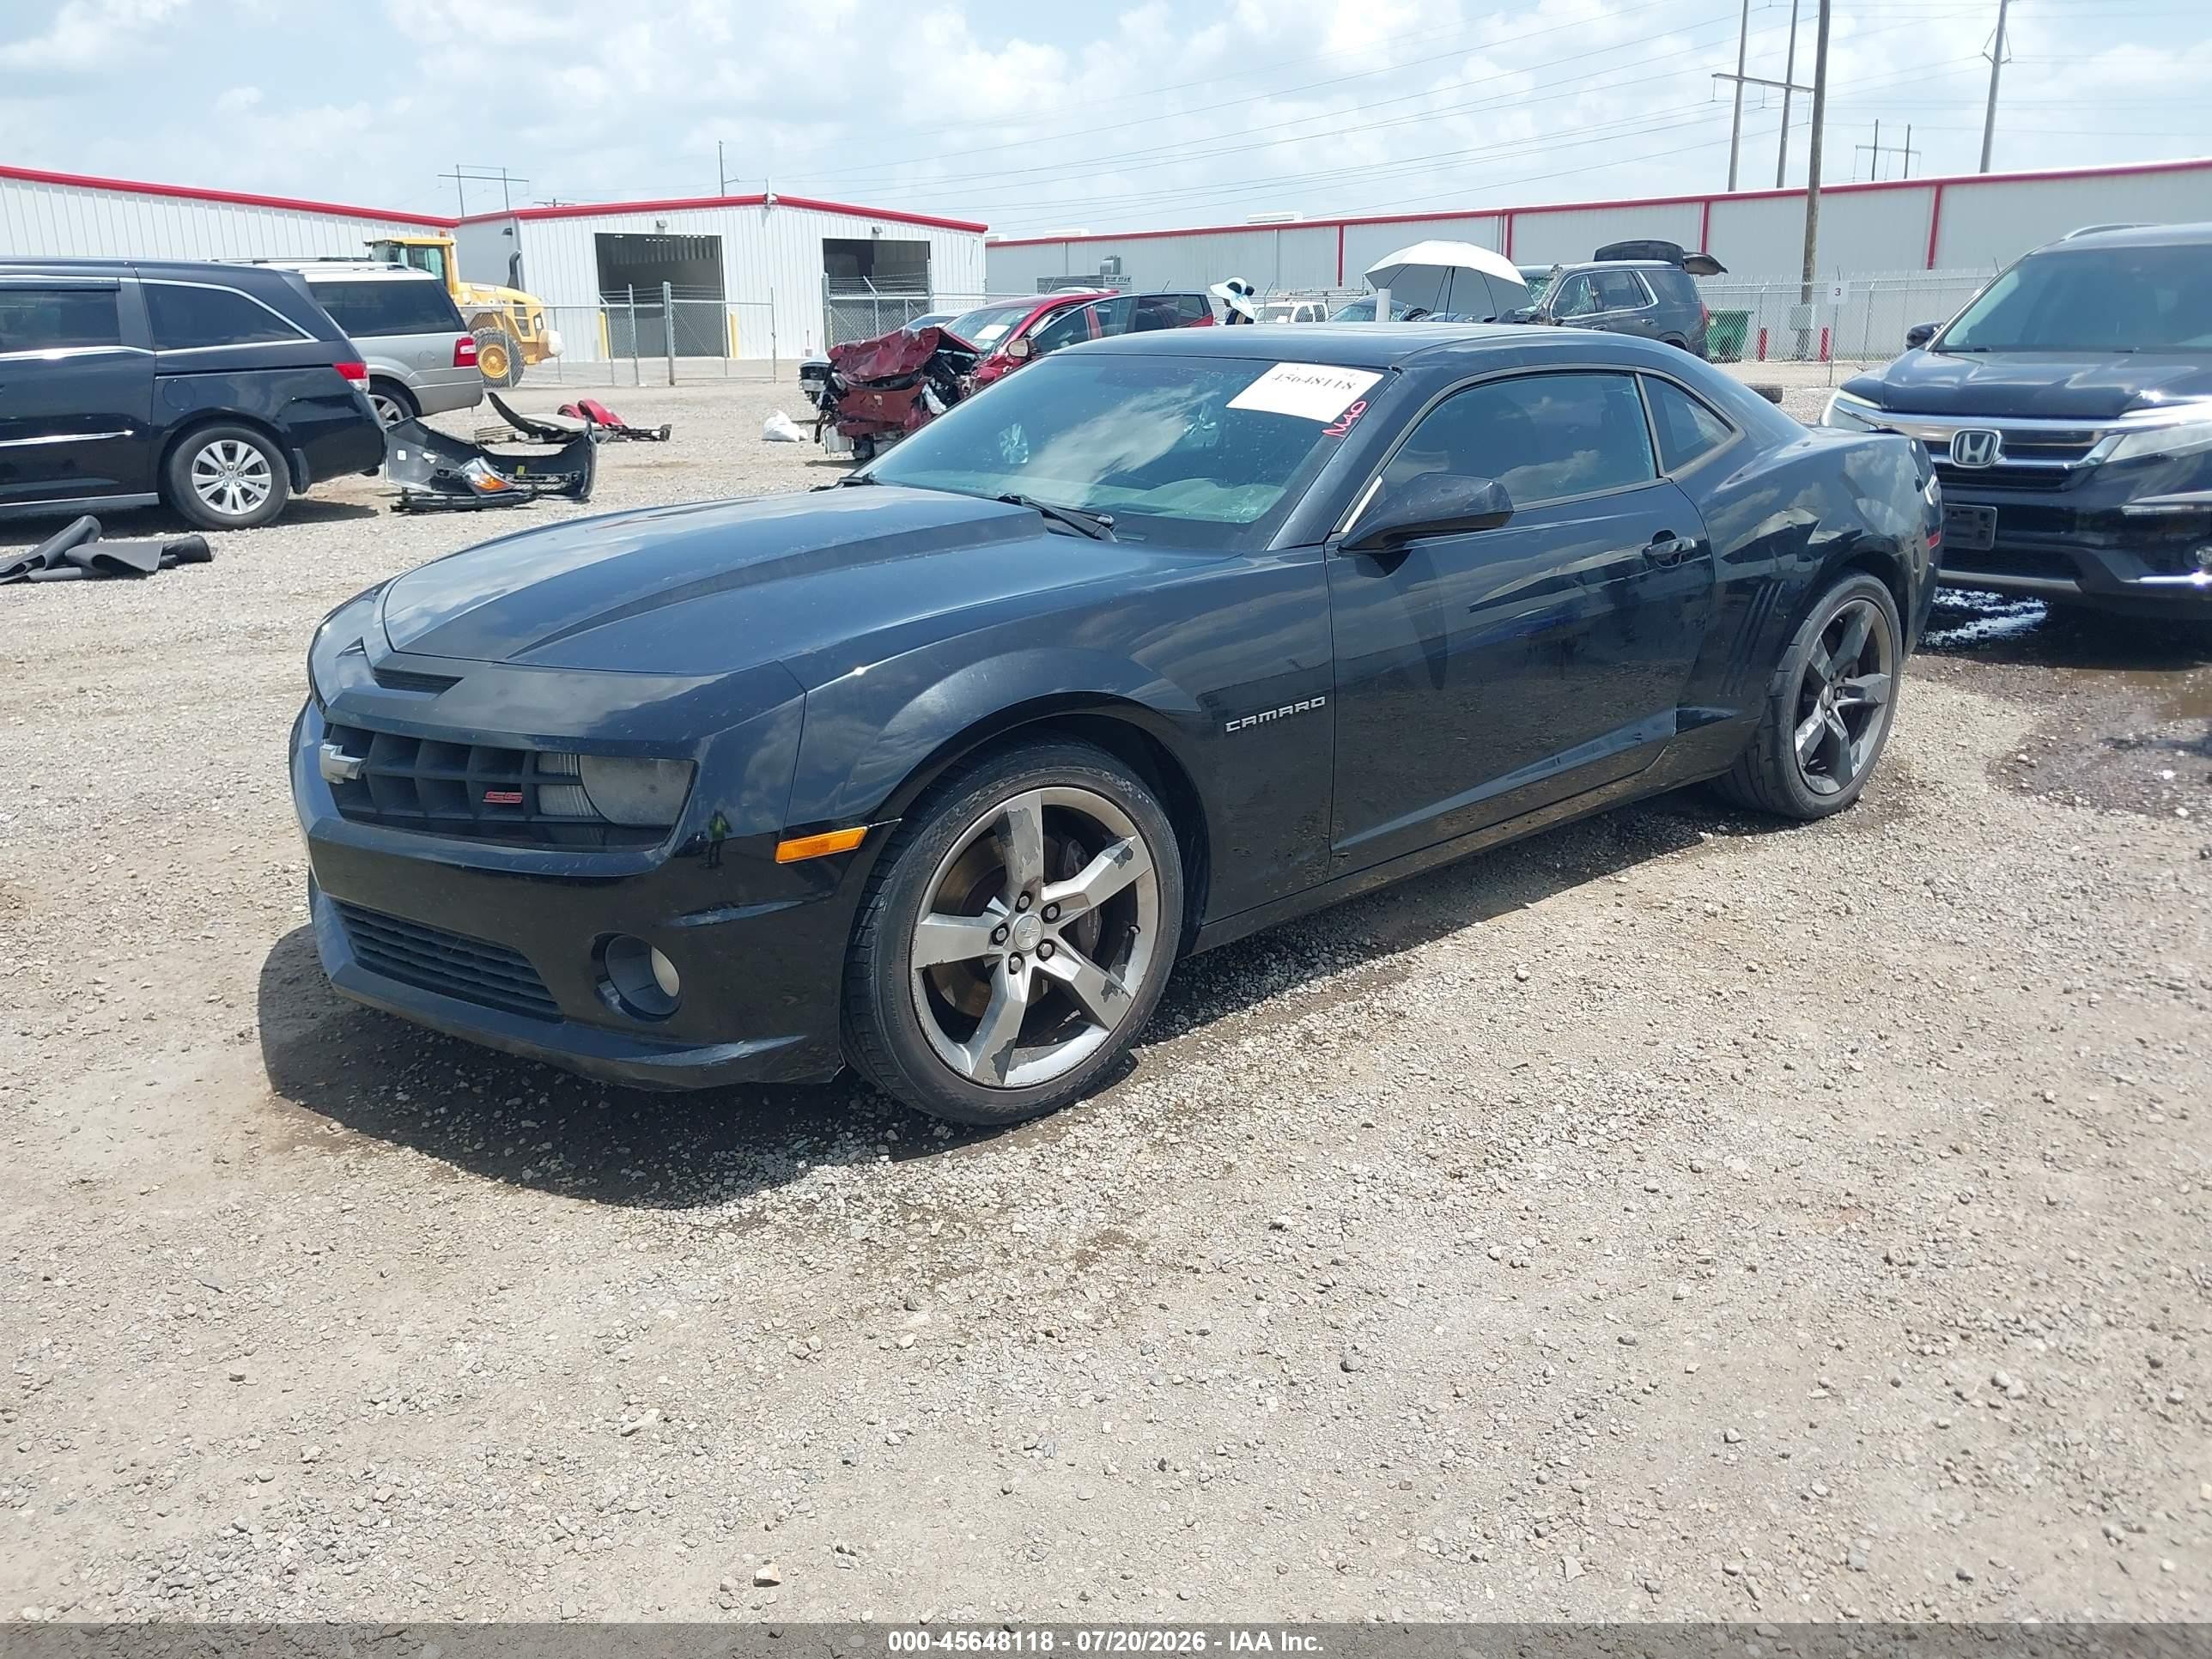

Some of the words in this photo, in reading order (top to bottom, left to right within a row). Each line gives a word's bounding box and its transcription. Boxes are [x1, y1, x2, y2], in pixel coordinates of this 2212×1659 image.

[1834, 288, 1842, 296] 3
[1225, 696, 1327, 732] CAMARO
[483, 791, 523, 804] SS
